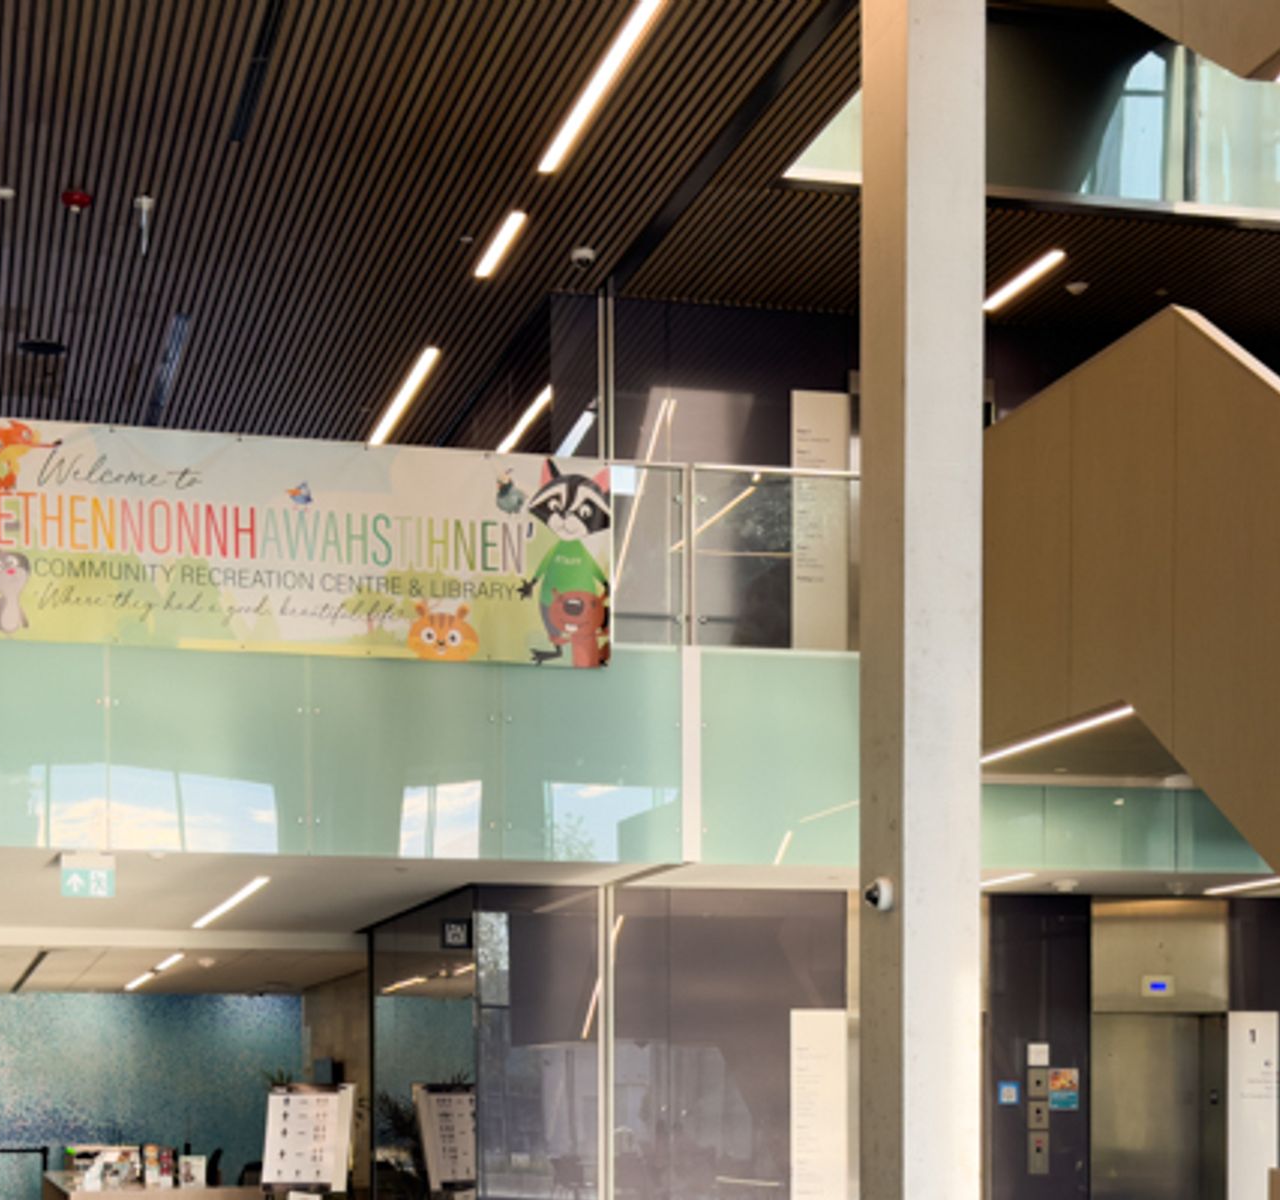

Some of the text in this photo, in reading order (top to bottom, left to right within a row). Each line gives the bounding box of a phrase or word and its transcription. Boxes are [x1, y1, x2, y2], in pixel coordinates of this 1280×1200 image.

[37, 446, 203, 490] Welcome to
[34, 557, 516, 600] COMMUNITY RECREATION CENTRE & LIBRARY
[107, 588, 152, 622] they
[163, 591, 203, 613] had
